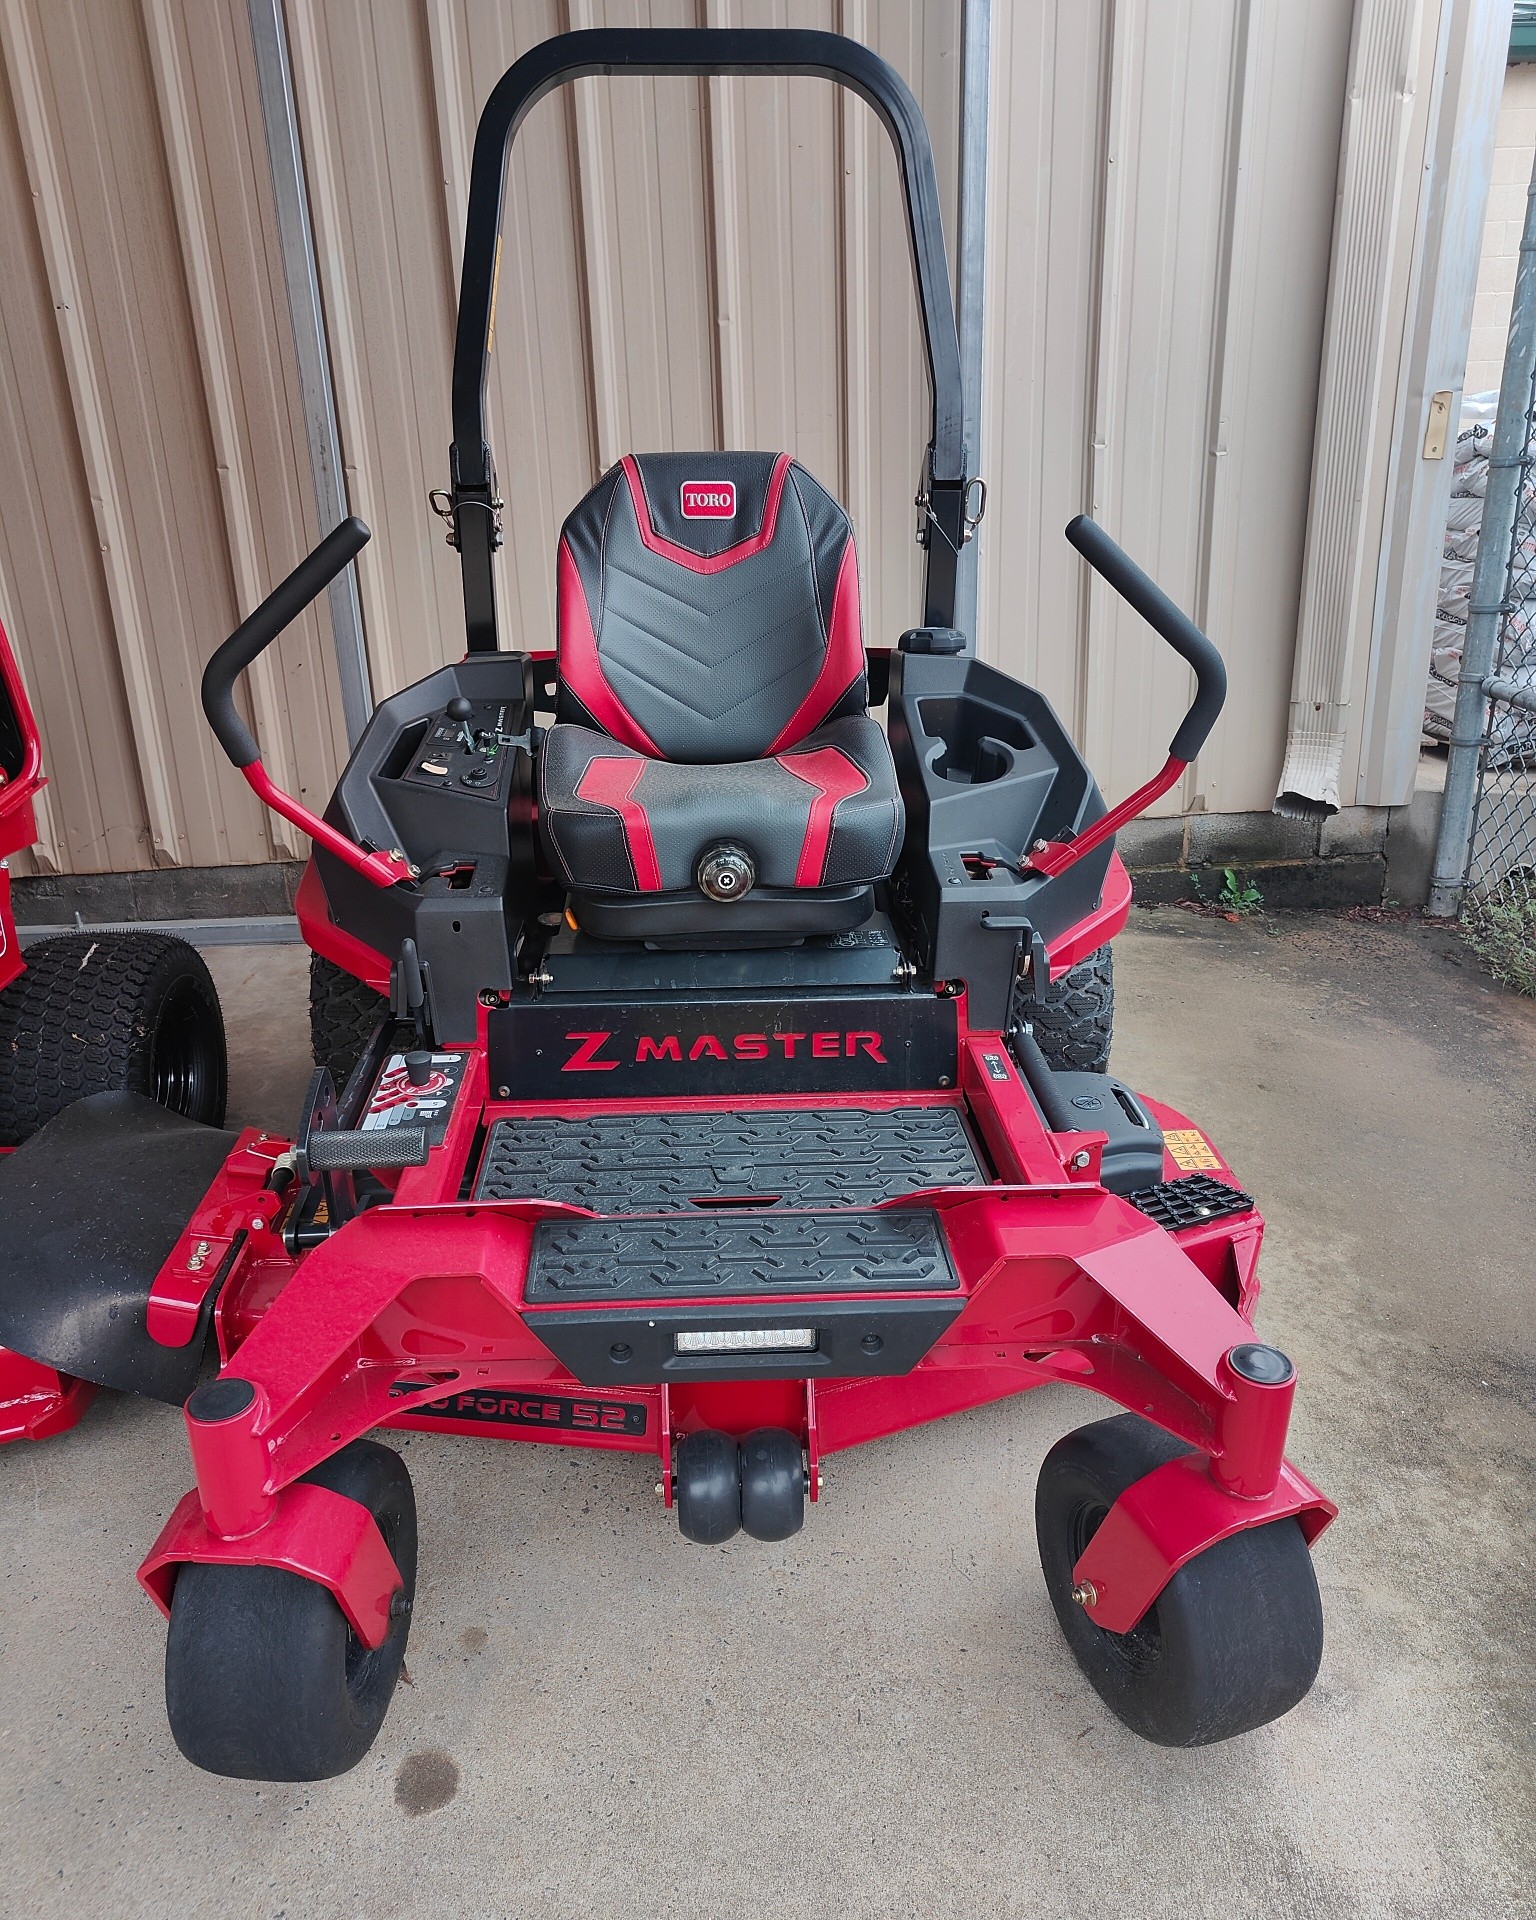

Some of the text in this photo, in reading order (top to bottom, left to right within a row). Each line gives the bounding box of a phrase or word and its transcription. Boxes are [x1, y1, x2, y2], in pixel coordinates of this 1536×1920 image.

[686, 493, 731, 507] TORO
[497, 706, 507, 727] MASTER
[561, 1031, 888, 1071] Z MASTER
[457, 1396, 561, 1421] FORCE
[571, 1403, 626, 1429] 52
